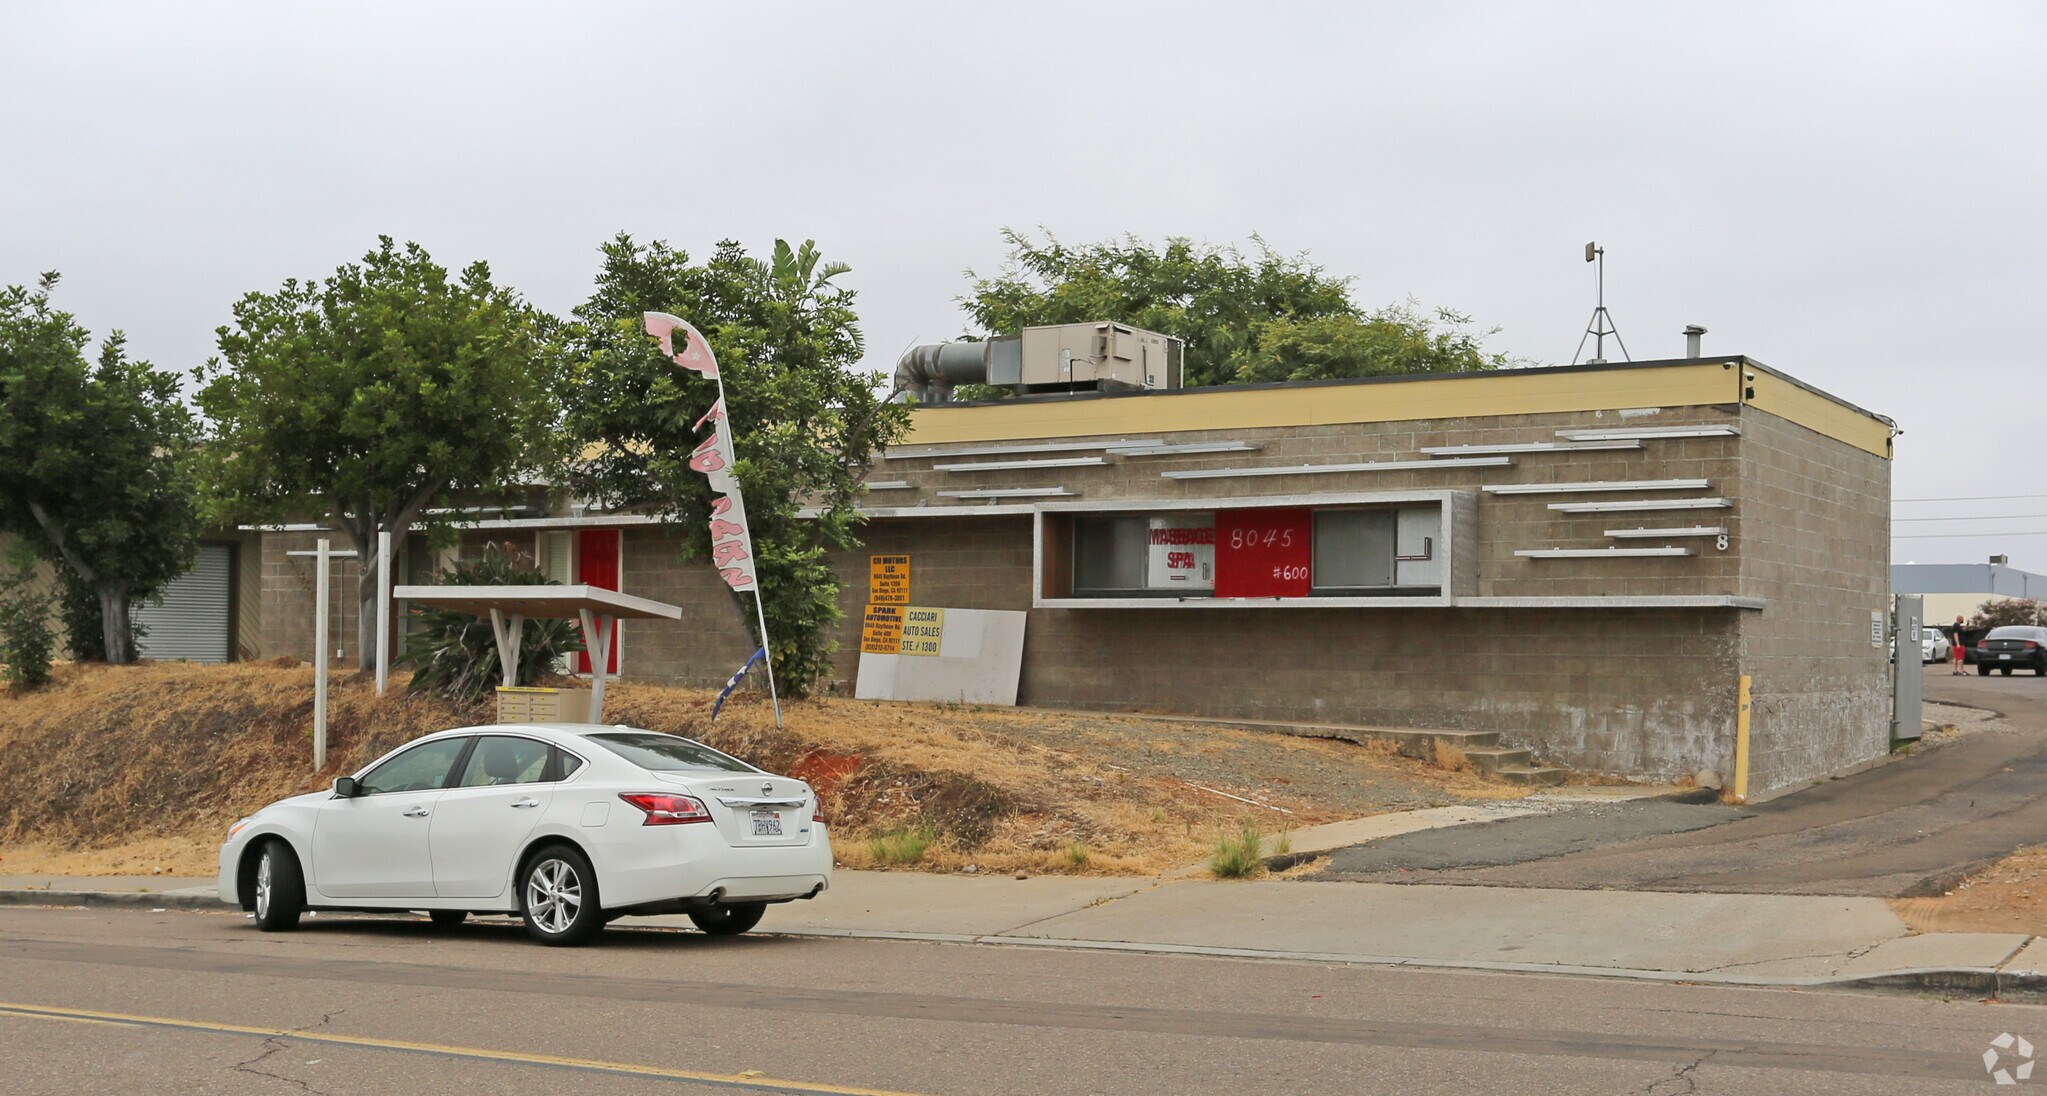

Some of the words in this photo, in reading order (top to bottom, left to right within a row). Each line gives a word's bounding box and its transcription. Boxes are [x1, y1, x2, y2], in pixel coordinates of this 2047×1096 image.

[1230, 529, 1294, 549] 8045
[1716, 534, 1728, 551] 8
[1167, 552, 1195, 569] SPA
[1273, 565, 1308, 580] #600
[866, 614, 902, 622] AUTOMOTIVE
[909, 612, 938, 622] CACCIARI
[903, 626, 920, 636] AUTO
[920, 627, 940, 637] SALES
[902, 641, 915, 651] STE.
[921, 642, 937, 652] 1300
